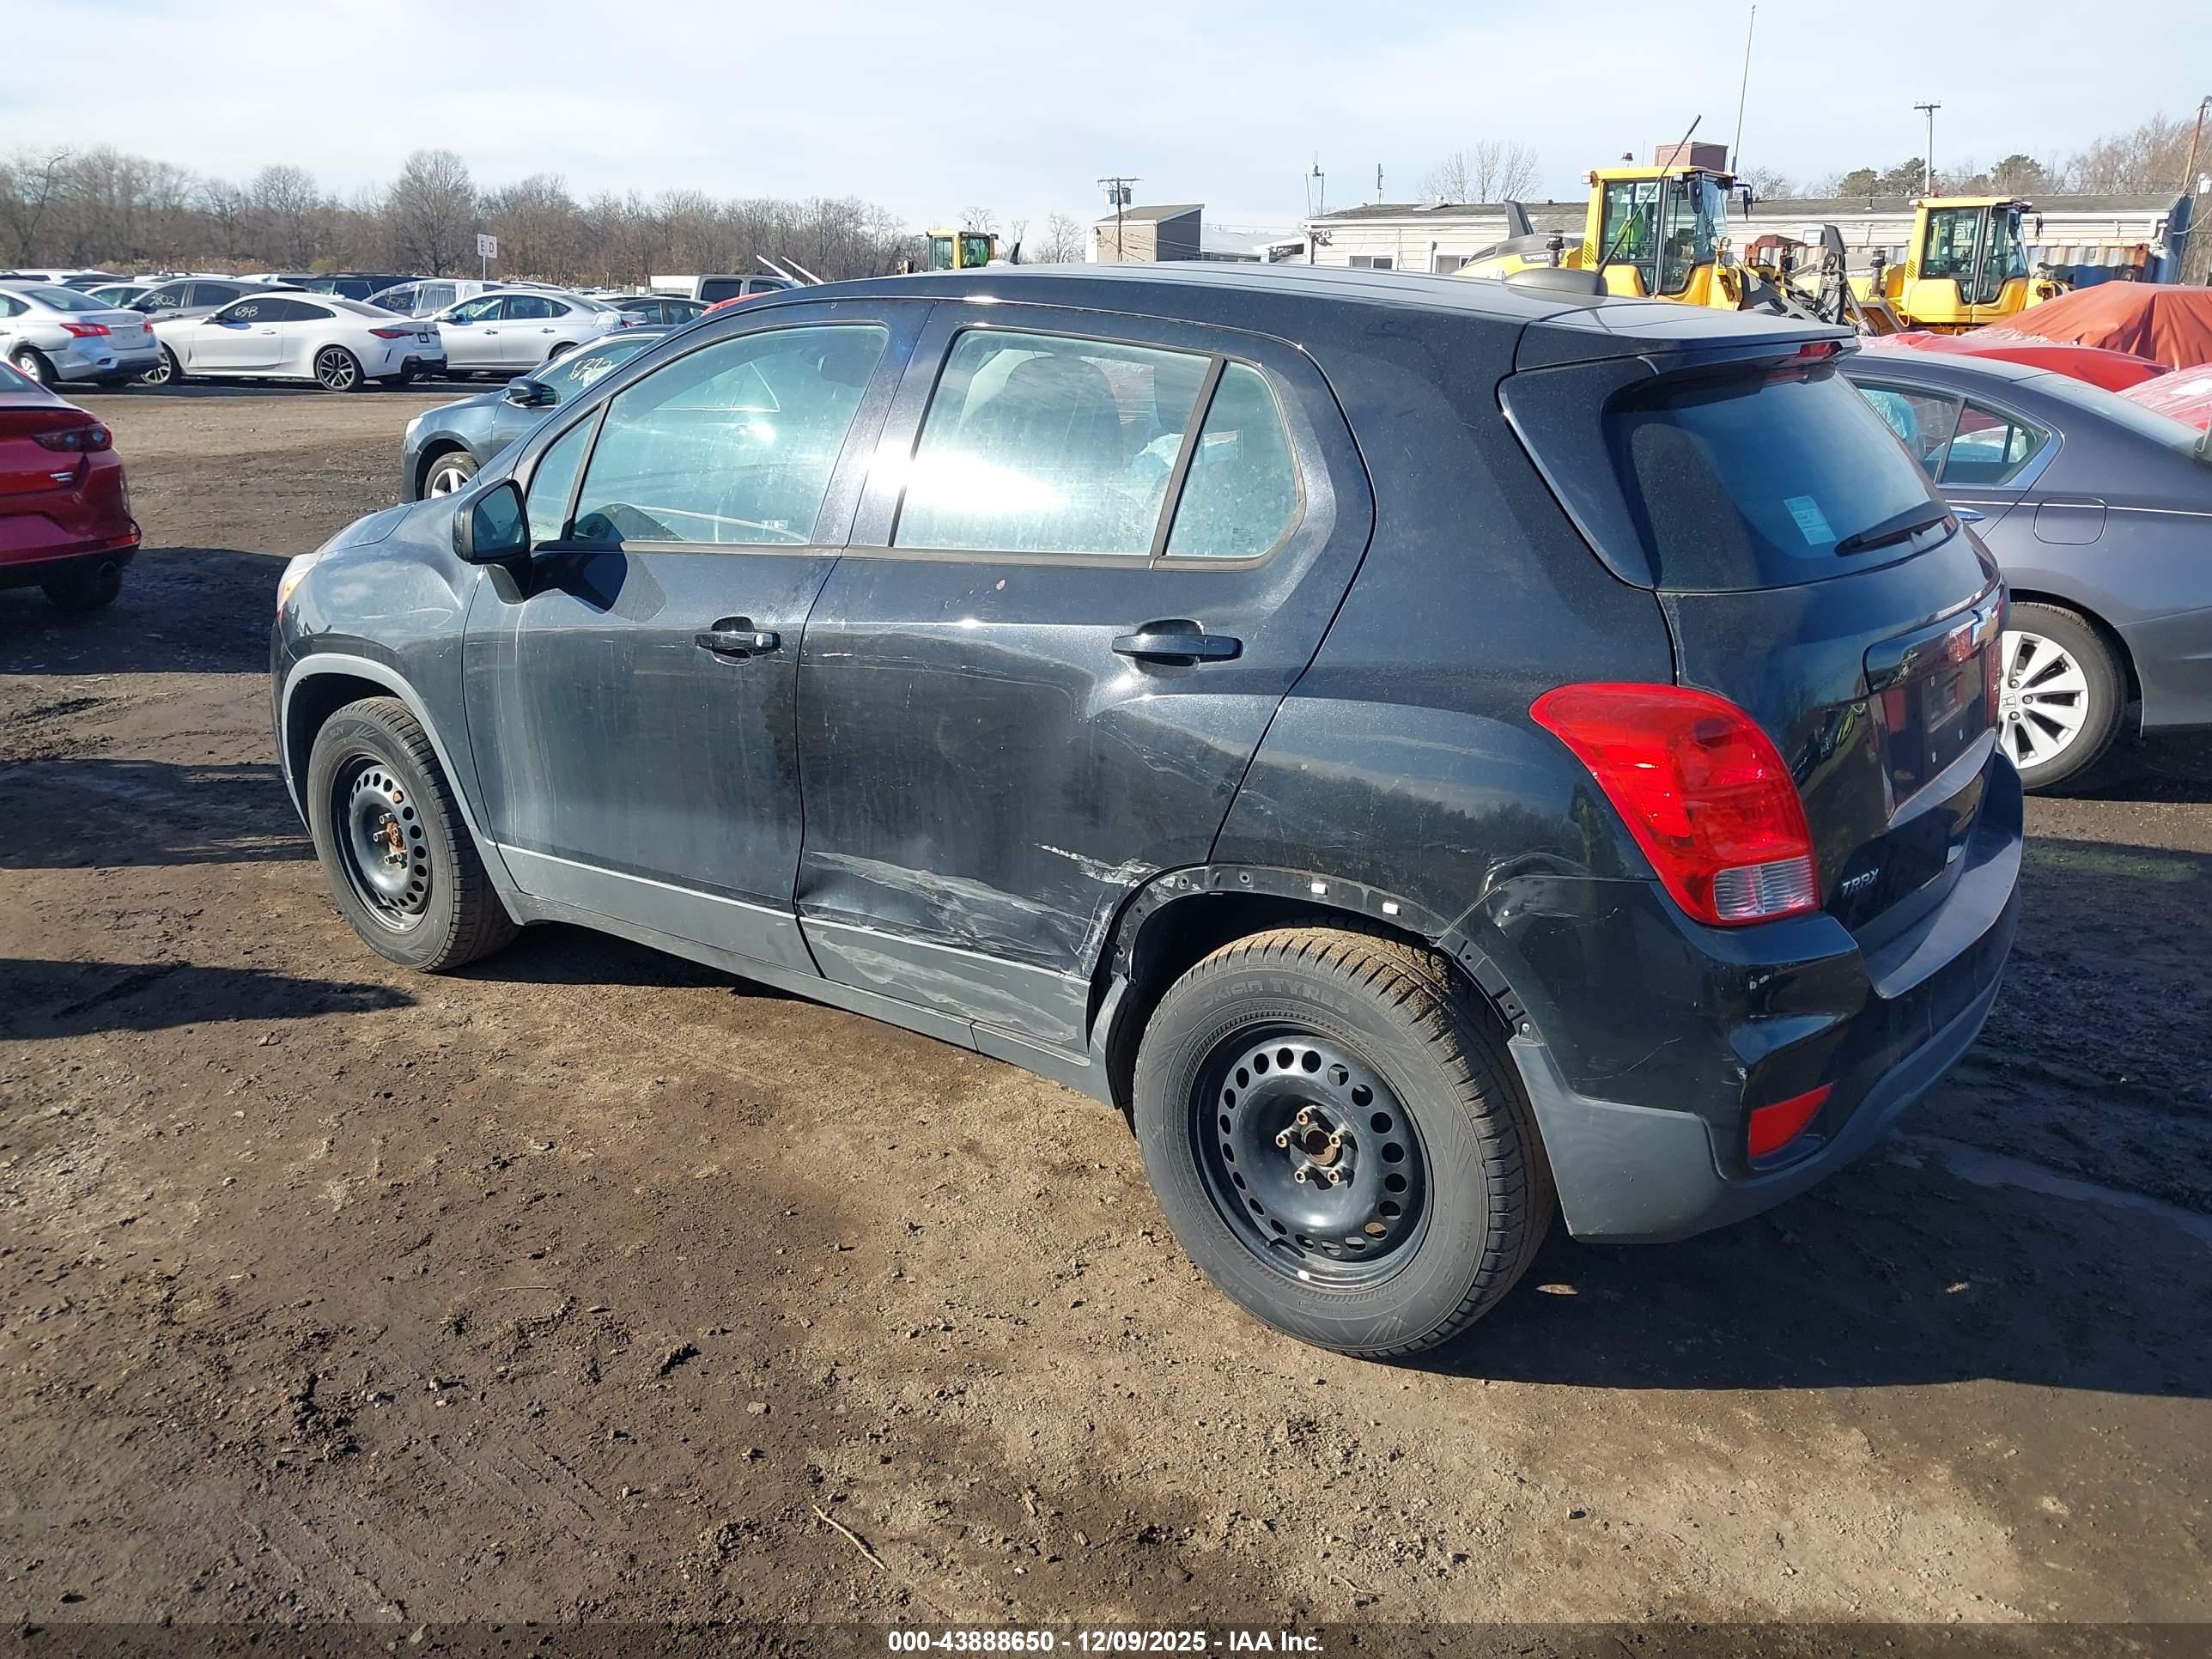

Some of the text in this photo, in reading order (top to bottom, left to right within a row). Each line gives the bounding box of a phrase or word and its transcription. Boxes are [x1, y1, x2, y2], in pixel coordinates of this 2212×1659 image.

[481, 240, 495, 253] E D
[234, 305, 258, 319] 6343
[1841, 868, 1879, 896] TRAX
